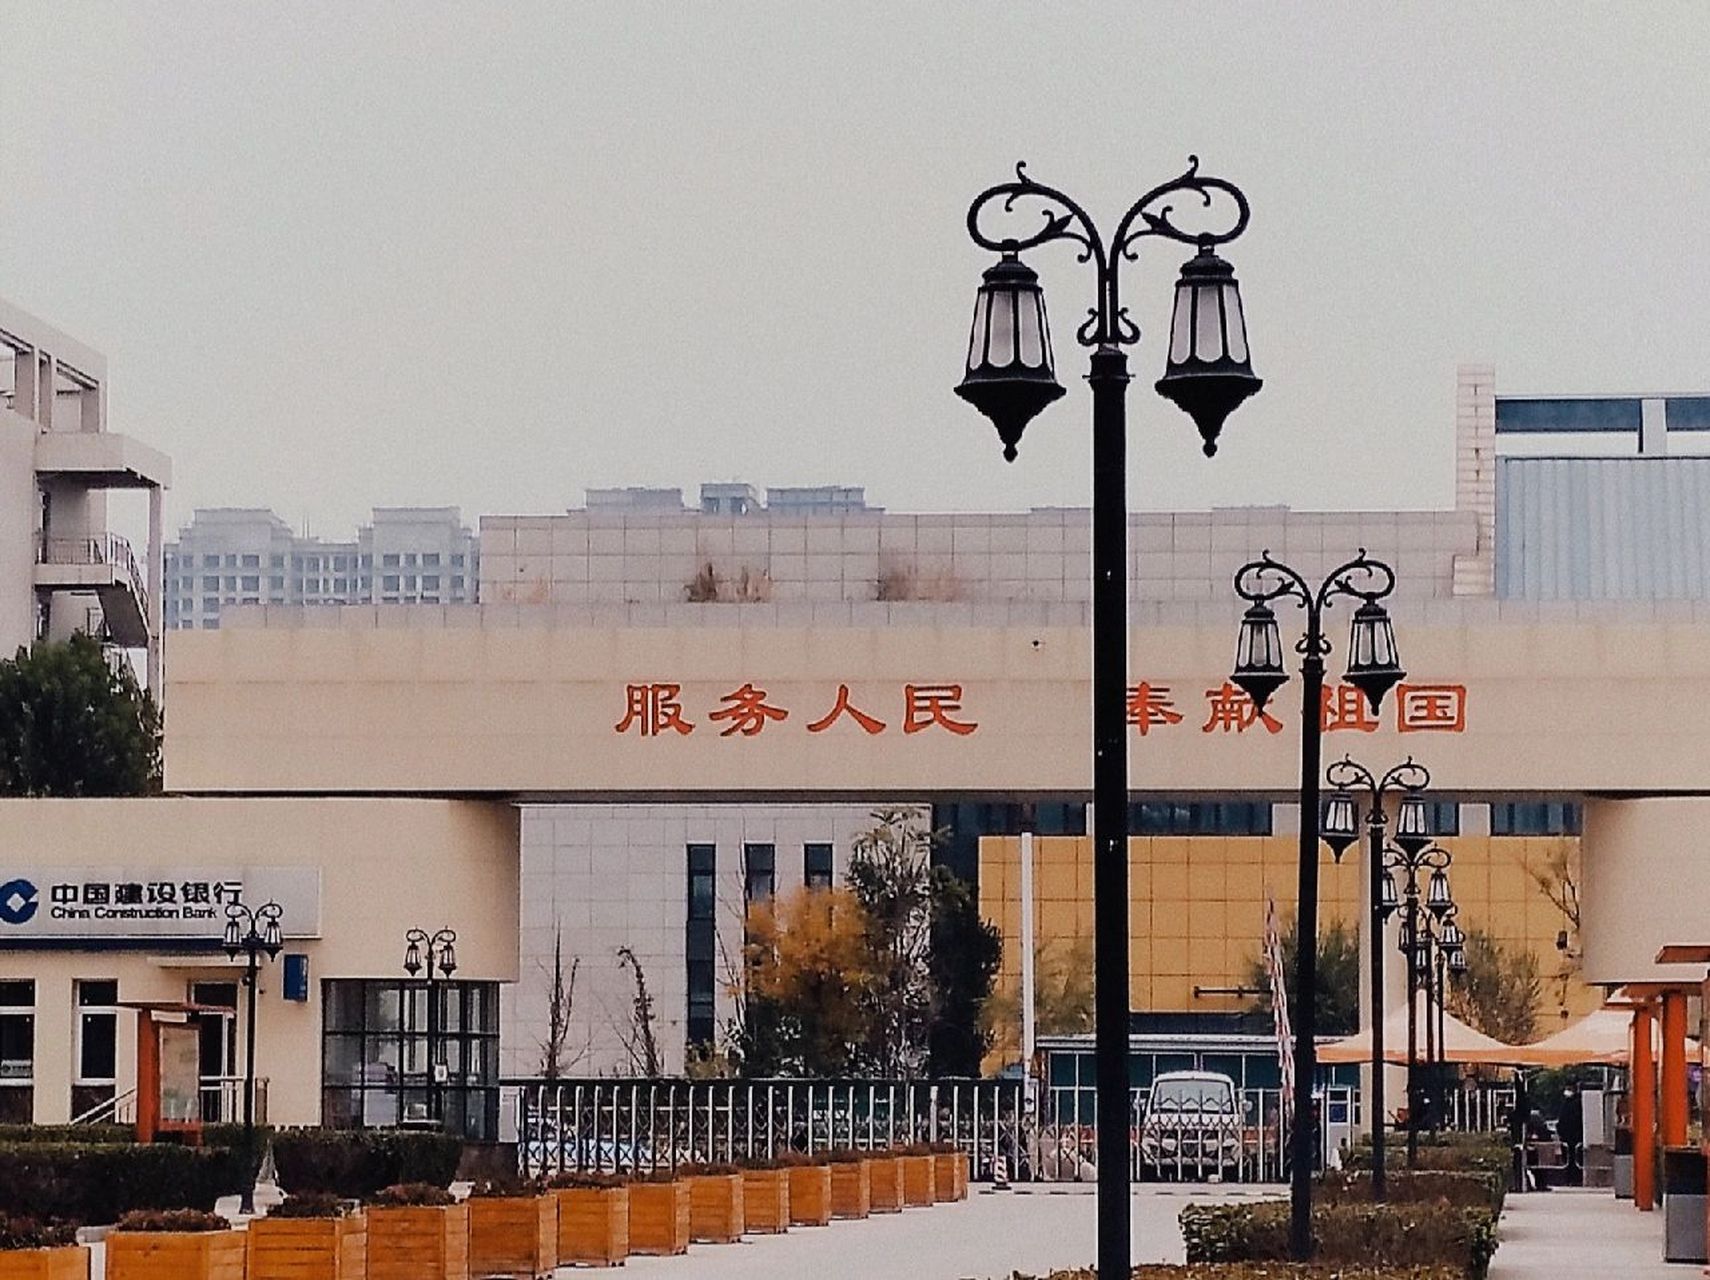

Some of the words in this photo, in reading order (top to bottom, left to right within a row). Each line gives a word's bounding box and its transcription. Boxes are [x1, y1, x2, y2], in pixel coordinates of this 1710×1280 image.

[615, 683, 978, 736] 服务人民
[51, 882, 242, 904] 中国建设银行
[50, 906, 90, 919] China
[94, 906, 179, 919] Construction
[183, 906, 218, 919] Bank
